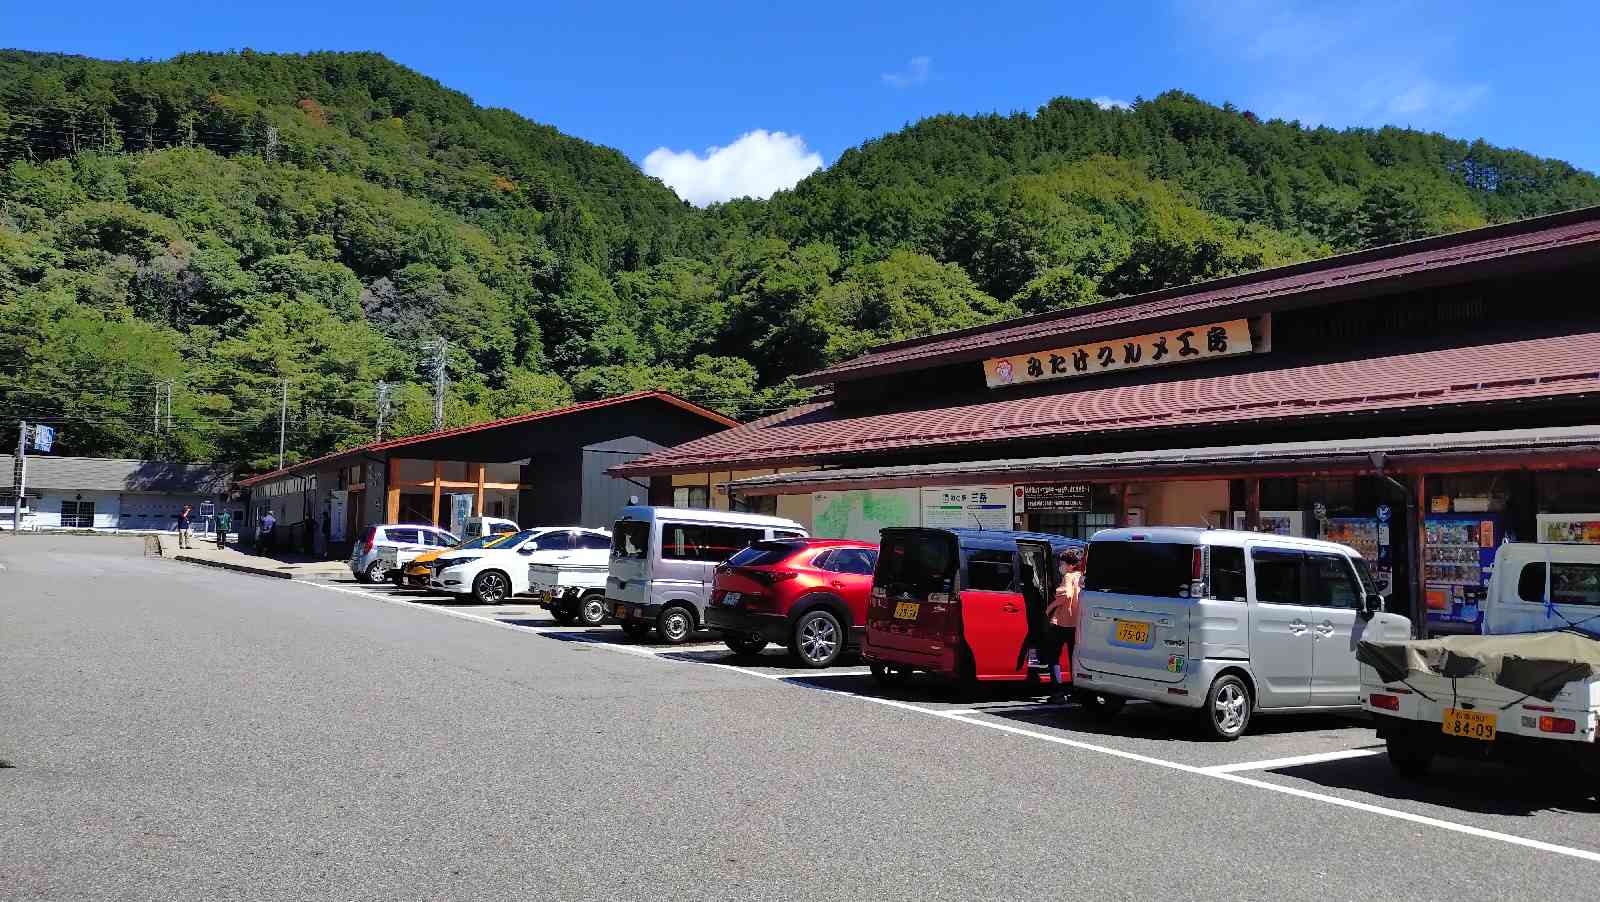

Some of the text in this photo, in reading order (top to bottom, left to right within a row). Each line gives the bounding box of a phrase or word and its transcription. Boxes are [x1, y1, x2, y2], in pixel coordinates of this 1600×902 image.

[1027, 326, 1229, 377] みたけグルメ工房
[1454, 720, 1493, 738] 84-09
